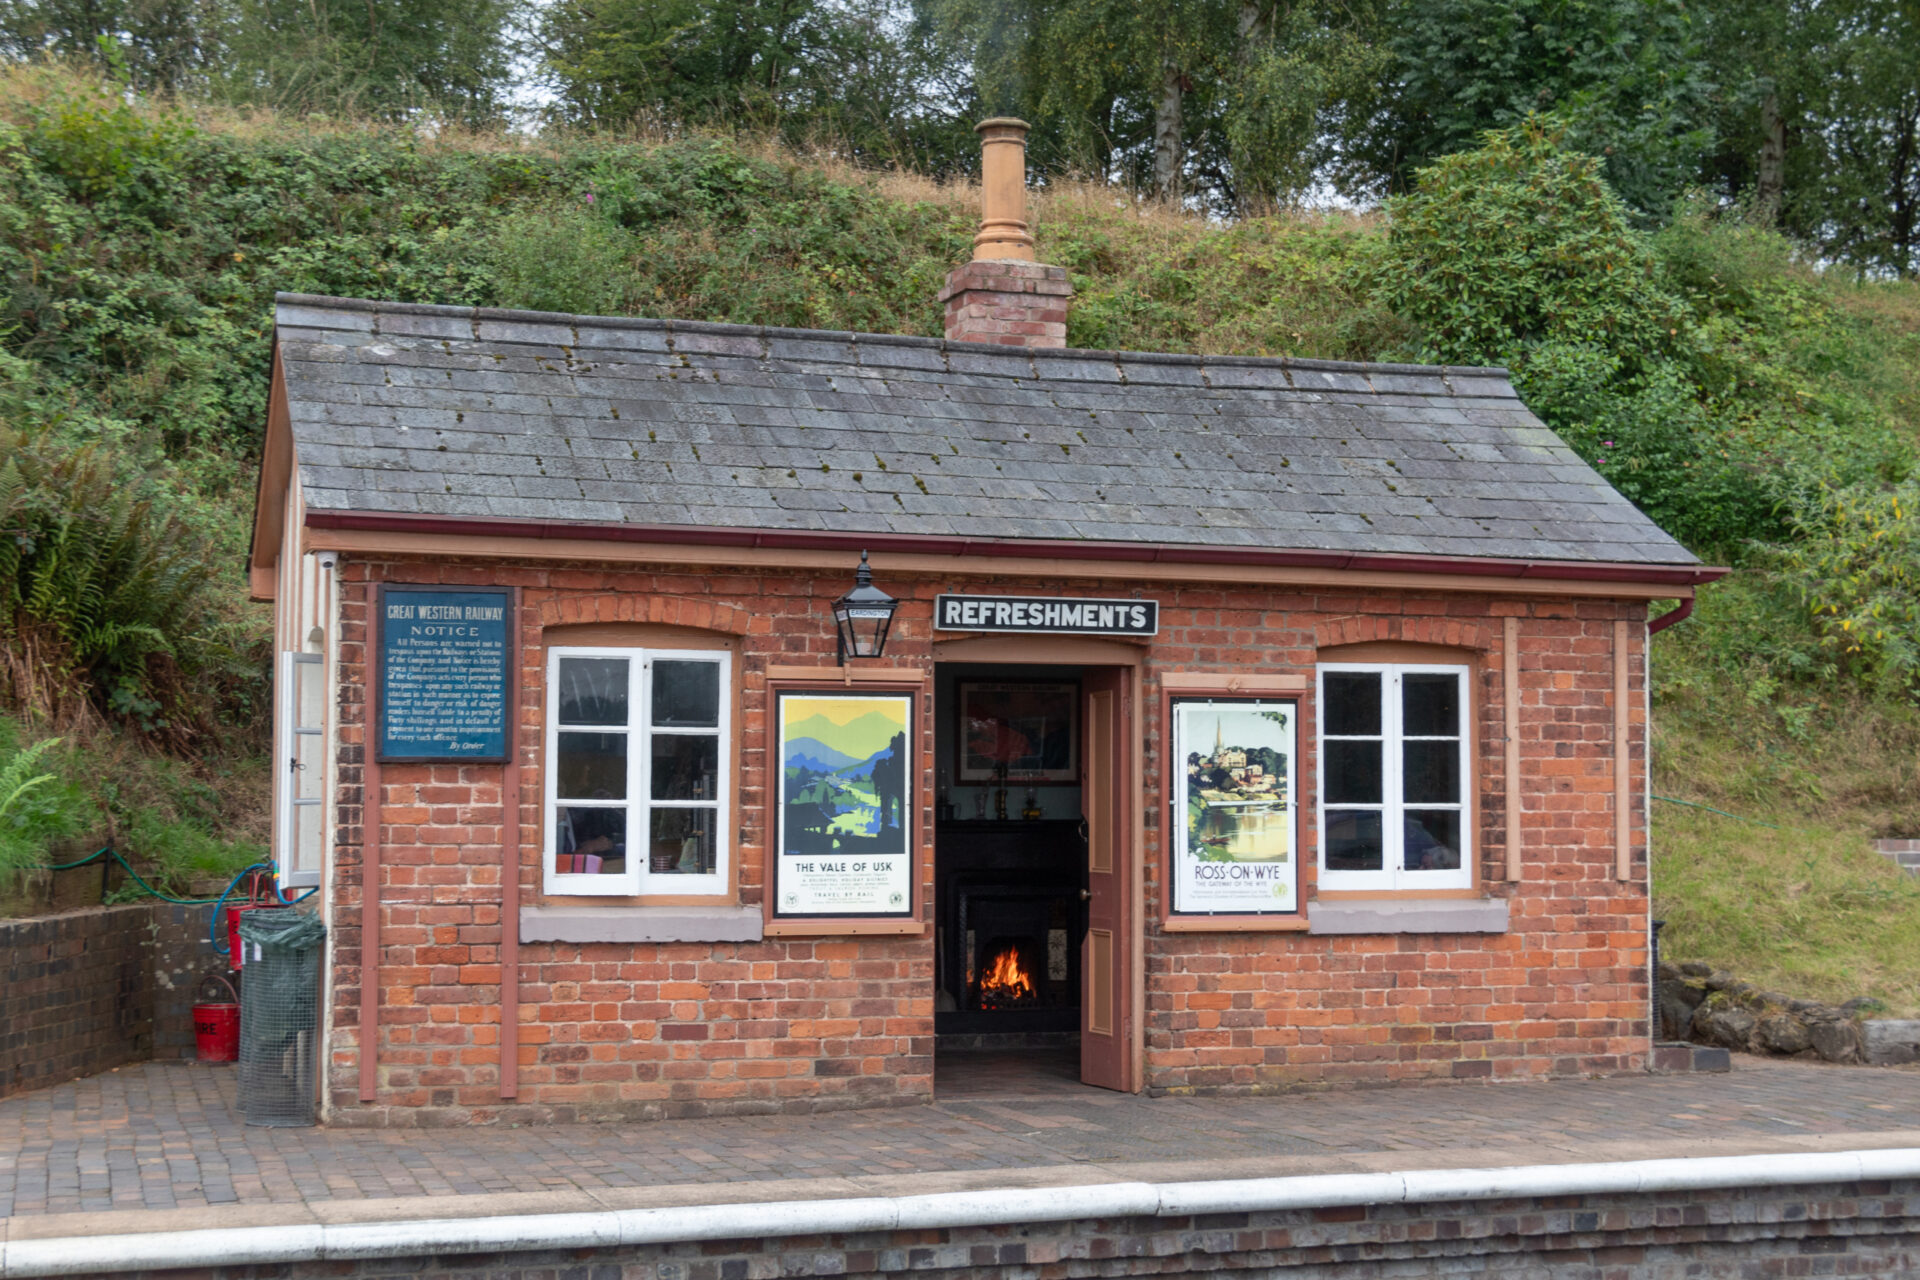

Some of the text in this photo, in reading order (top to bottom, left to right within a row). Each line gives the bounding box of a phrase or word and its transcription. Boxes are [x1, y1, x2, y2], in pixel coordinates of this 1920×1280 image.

[387, 605, 503, 620] GREAT WESTERN RAILWAY
[945, 600, 1147, 628] REFRESHMENTS
[411, 626, 479, 637] NOTICE
[410, 638, 438, 646] Persons
[796, 862, 893, 872] THE VALE OF USK
